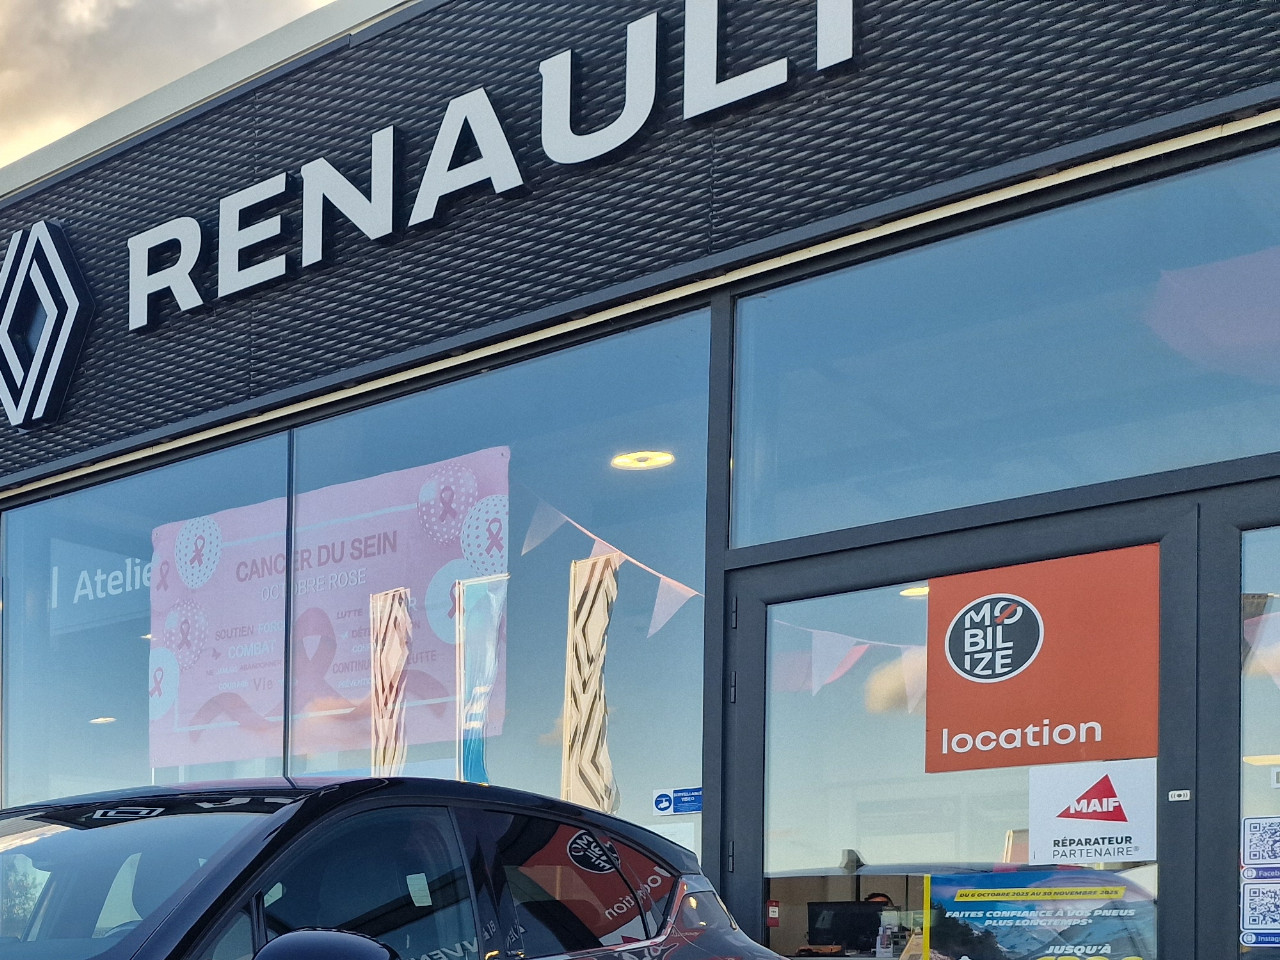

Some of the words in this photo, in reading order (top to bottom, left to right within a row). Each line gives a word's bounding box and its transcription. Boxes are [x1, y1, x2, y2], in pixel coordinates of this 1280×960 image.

[317, 540, 345, 567] DU
[349, 530, 398, 561] SEIN
[72, 556, 153, 605] Atelie
[328, 567, 368, 591] ROSE
[214, 625, 255, 641] SOUTIEN
[258, 620, 285, 633] FORC
[227, 640, 277, 658] COMBAT
[253, 677, 274, 692] Vie
[942, 719, 1102, 755] location
[1069, 798, 1120, 814] MAIF
[1053, 836, 1133, 848] RÉPARATEUR
[1258, 869, 1280, 877] Faceb
[985, 910, 1054, 918] CONFIANCE
[1055, 909, 1064, 917] À
[1067, 909, 1092, 917] VOS
[1093, 909, 1136, 917] PNEUS
[1258, 935, 1280, 943] Instag
[1044, 944, 1112, 956] JUSQU'À
